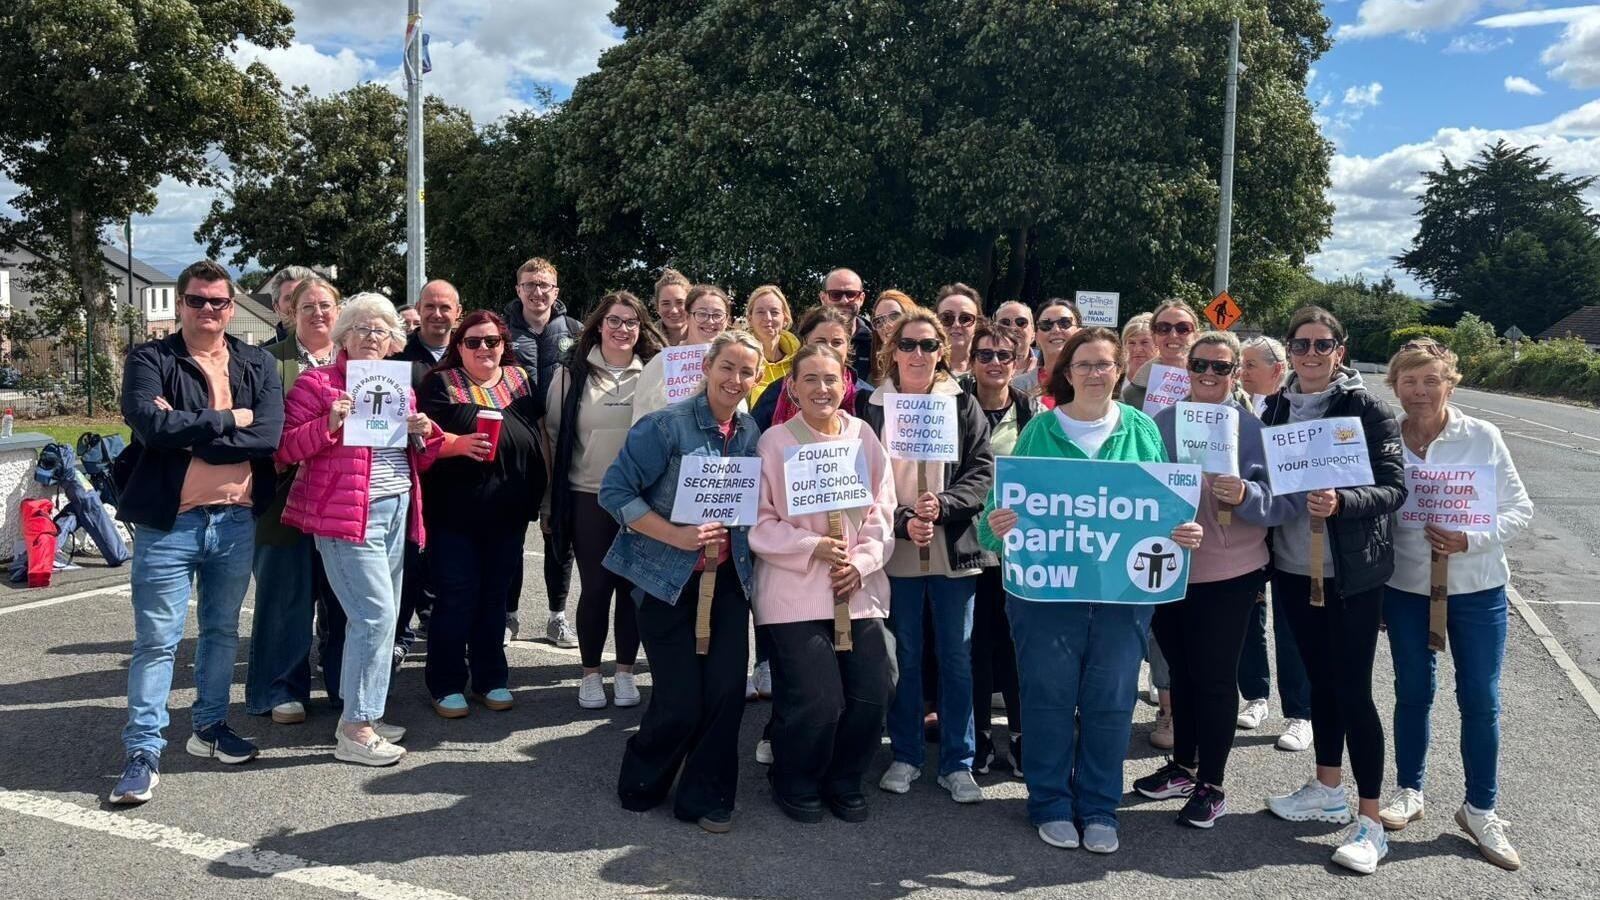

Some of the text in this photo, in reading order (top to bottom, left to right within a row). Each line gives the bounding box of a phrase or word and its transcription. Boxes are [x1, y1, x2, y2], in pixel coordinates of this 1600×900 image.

[681, 362, 701, 372] ARE
[361, 375, 387, 386] PARITY
[387, 377, 394, 386] IN
[393, 384, 406, 416] SCHOOLS
[668, 387, 690, 398] OUR
[1163, 384, 1188, 395] SICK
[896, 399, 947, 411] EQUALITY
[366, 416, 388, 430] FÓRSA
[897, 414, 945, 425] FOR OUR
[900, 428, 943, 439] SCHOOL
[891, 441, 954, 454] SECRETARIES
[1182, 439, 1208, 449] YOUR
[798, 446, 850, 461] EQUALITY
[701, 463, 742, 474] SCHOOL
[815, 462, 838, 474] FOR
[1277, 455, 1360, 472] YOUR SUPPORT
[1168, 469, 1198, 487] FÓRSA
[1411, 470, 1477, 481] EQUALITY
[683, 477, 756, 489] SECRETARIES
[791, 474, 864, 492] OUR SCHOOL
[1414, 484, 1474, 495] FOR OUR
[694, 492, 743, 503] DESERVE
[792, 488, 867, 507] SECRETARIES
[1002, 482, 1160, 522] Pension
[1417, 498, 1472, 510] SCHOOL
[701, 507, 735, 518] MORE
[1402, 511, 1491, 524] SECRETARIES
[1003, 520, 1121, 562] parity
[1005, 560, 1079, 588] now
